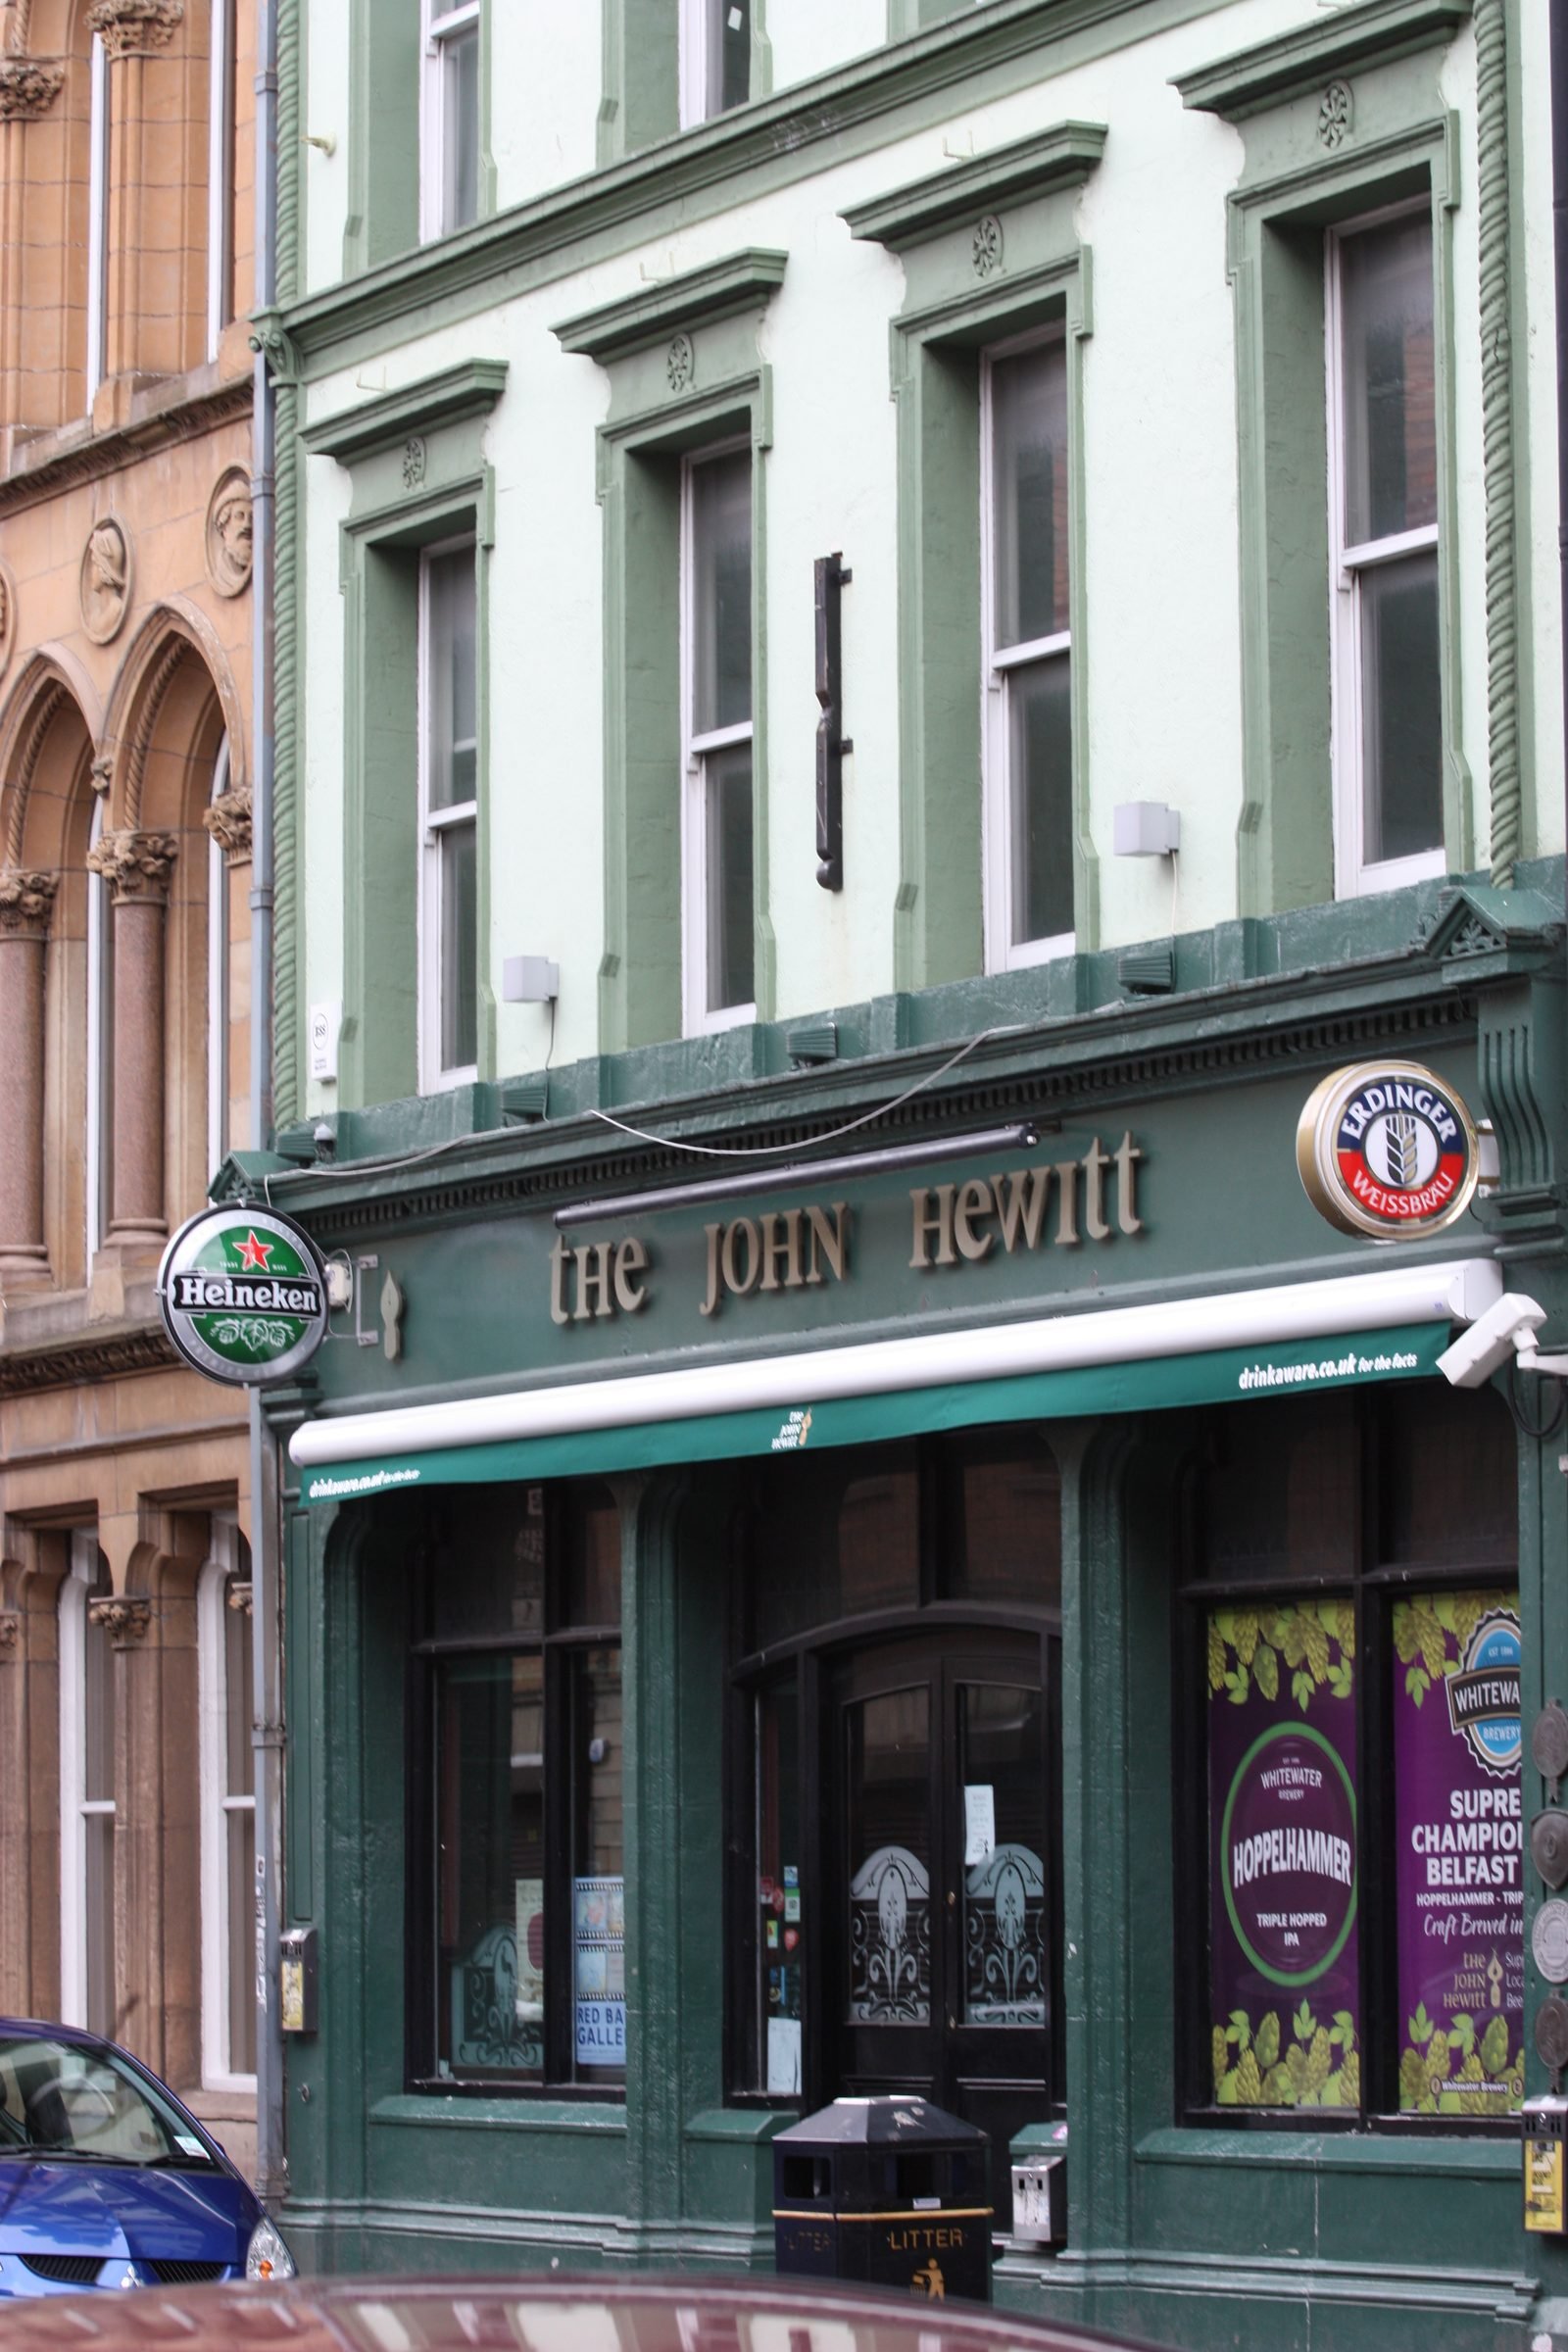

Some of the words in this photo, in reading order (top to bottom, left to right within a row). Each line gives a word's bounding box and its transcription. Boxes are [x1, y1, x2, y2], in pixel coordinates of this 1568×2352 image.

[1341, 1084, 1458, 1145] ERDINGER
[1353, 1171, 1454, 1215] WEISSBRÄU
[699, 1201, 849, 1316] JOHN
[180, 1277, 318, 1312] Heineken
[1239, 1352, 1357, 1390] drinkaware.co.uk
[1260, 1767, 1323, 1789] WHITEWATER
[1450, 1788, 1522, 1819] SUPRE
[1234, 1828, 1351, 1888] HOPPELHAMMER
[1426, 1854, 1518, 1886] BELFAST
[1416, 1891, 1494, 1907] HOPPELHAMMER
[1256, 1913, 1288, 1928] TRIPLE
[1289, 1913, 1328, 1928] HOPPED
[1424, 1912, 1457, 1945] Craft
[1460, 1912, 1508, 1936] Brewed
[1284, 1932, 1299, 1946] IPA
[1453, 1973, 1486, 1991] JOHN
[578, 2007, 600, 2025] RED
[606, 2007, 623, 2025] BA
[578, 2027, 623, 2046] GALLE
[1442, 2080, 1480, 2093] Whitewater
[1481, 2080, 1508, 2095] Brewery
[890, 2227, 963, 2251] LITTER
